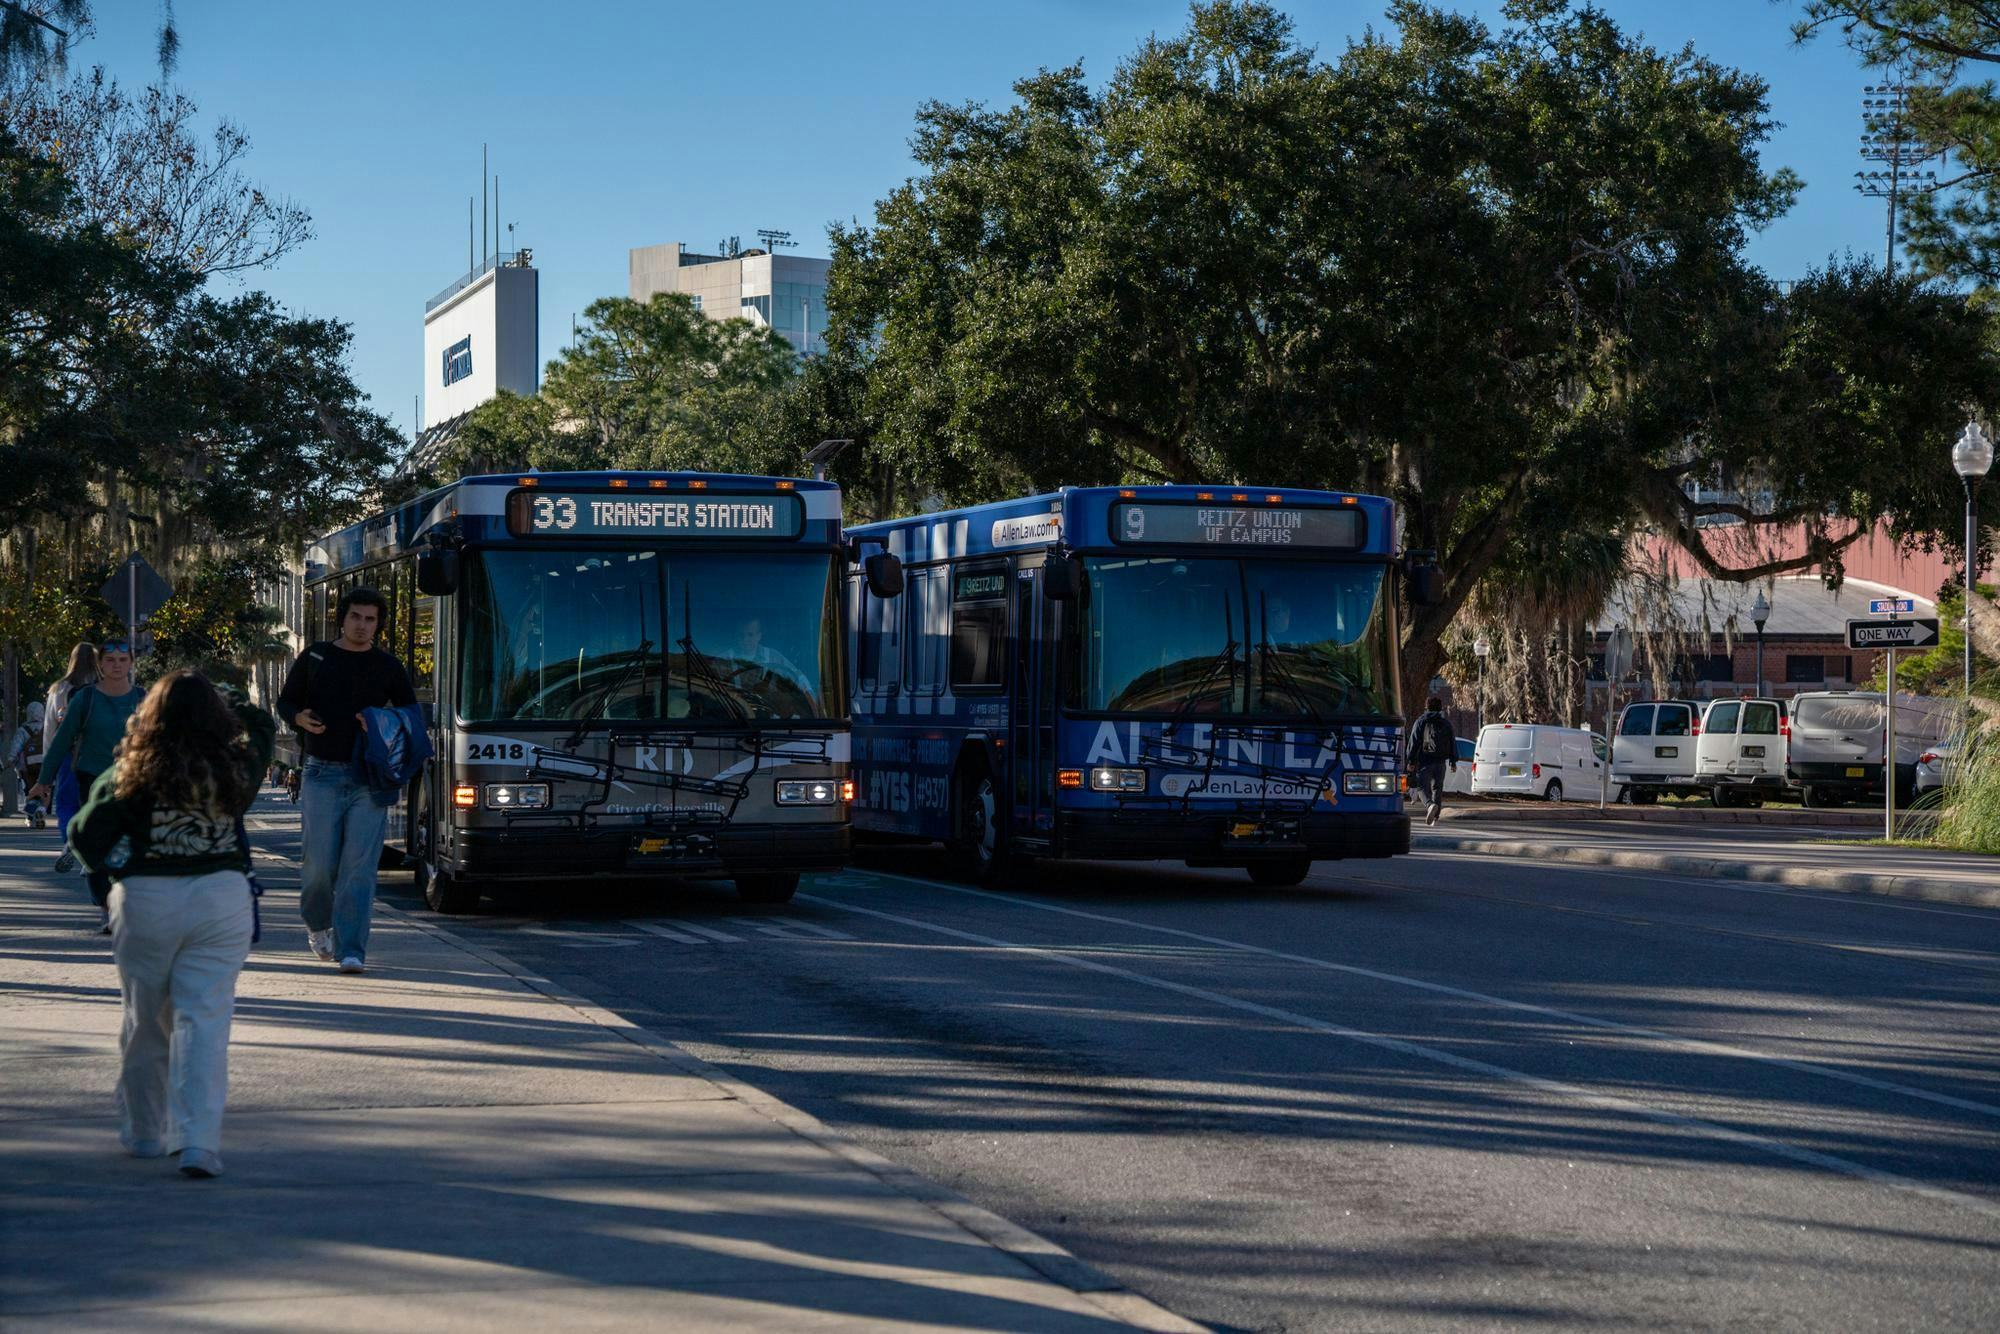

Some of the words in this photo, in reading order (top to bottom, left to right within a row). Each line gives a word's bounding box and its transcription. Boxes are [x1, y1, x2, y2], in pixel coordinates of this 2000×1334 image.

[534, 496, 577, 529] 33
[590, 501, 689, 528] TRANSFER
[695, 502, 774, 529] STATION
[1198, 510, 1247, 528] REITZ
[1253, 511, 1302, 528] UNION
[1001, 522, 1054, 541] AllenLaw.com
[1126, 507, 1145, 539] 9
[1206, 528, 1223, 542] UF
[1230, 528, 1292, 544] CAMPUS
[1859, 630, 1882, 640] ONE
[1886, 628, 1911, 639] WAY
[468, 743, 524, 760] 2418
[870, 769, 910, 814] #YES
[914, 773, 949, 812] (#937)
[606, 803, 633, 818] City
[636, 803, 651, 814] of
[652, 802, 726, 814] Gainesville
